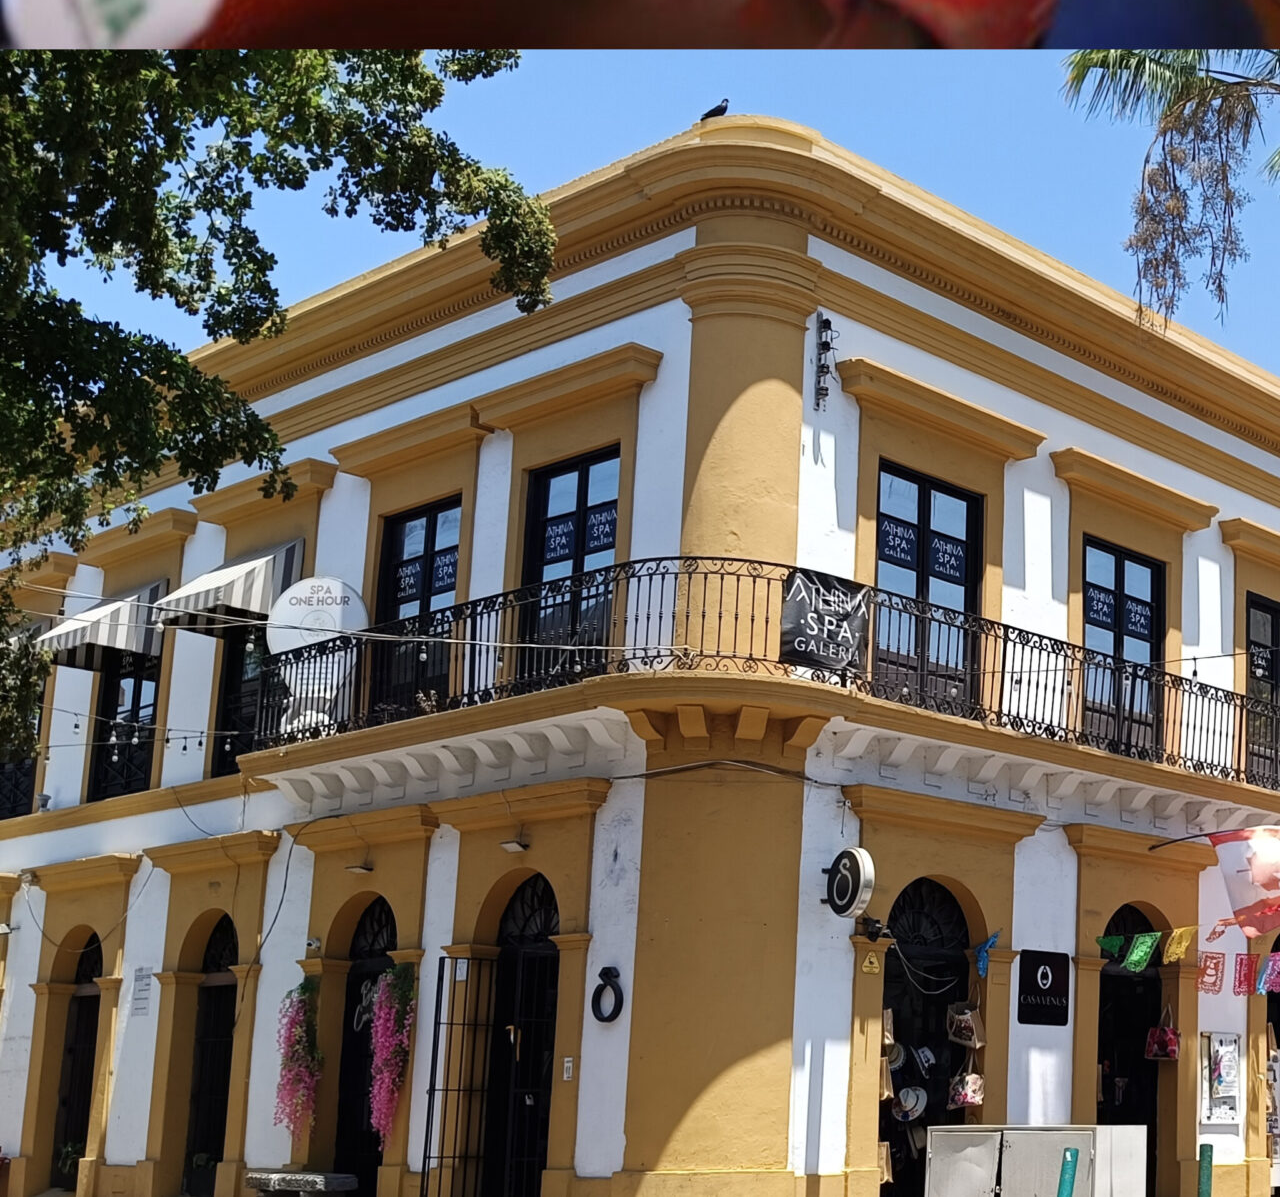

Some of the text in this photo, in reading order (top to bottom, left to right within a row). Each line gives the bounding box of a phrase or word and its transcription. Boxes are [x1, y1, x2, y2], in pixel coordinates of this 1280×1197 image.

[588, 509, 617, 525] ATHINA
[546, 521, 574, 538] ATHINA
[881, 521, 916, 541] ATHINA
[932, 539, 964, 558] ATHINA
[310, 585, 332, 595] SPA
[786, 573, 869, 620] ATHINA
[289, 596, 351, 606] ONE HOUR
[806, 612, 854, 645] SPA
[794, 637, 859, 664] GALERIA
[1020, 994, 1067, 1007] CASA VENUS
